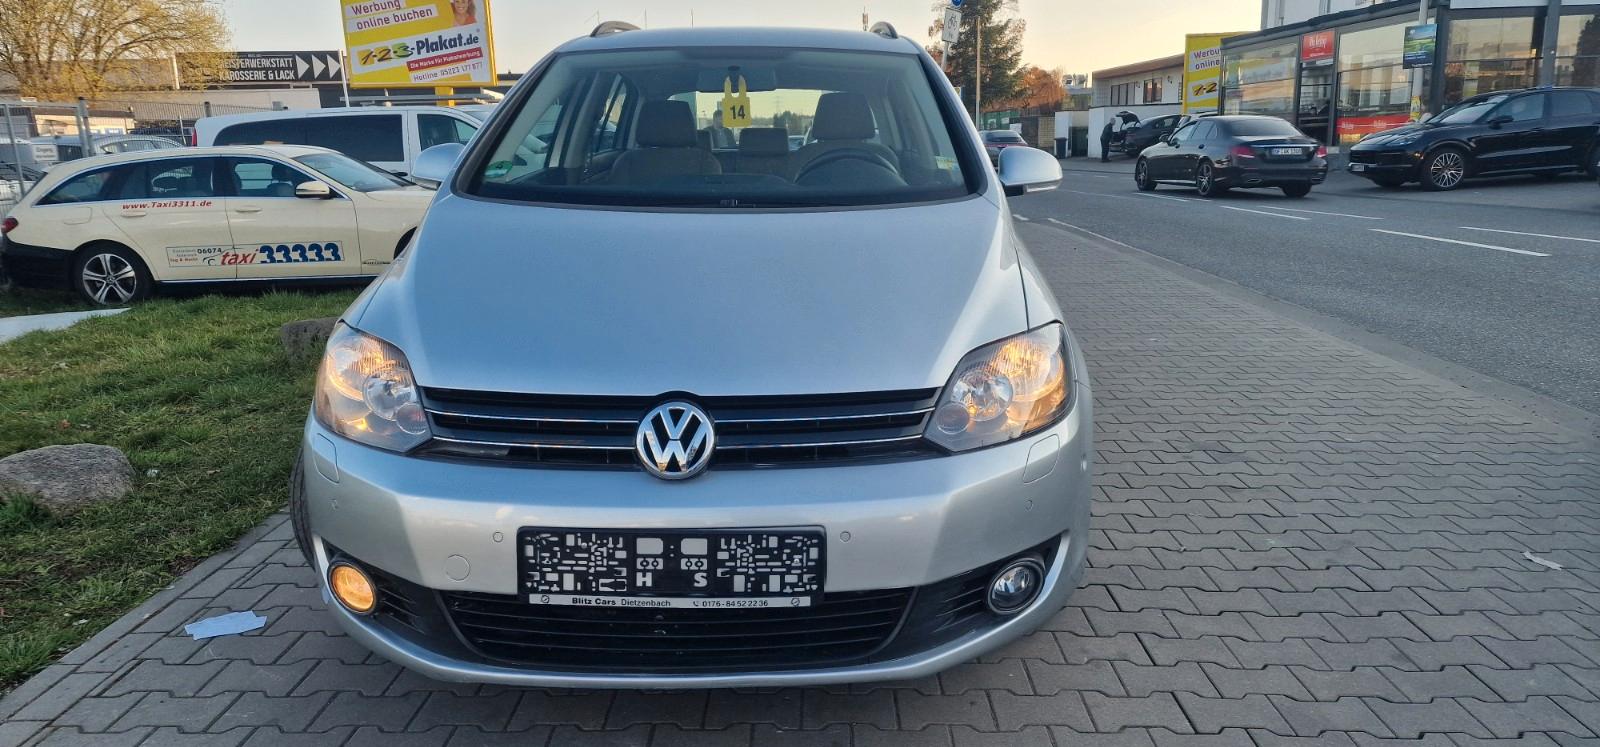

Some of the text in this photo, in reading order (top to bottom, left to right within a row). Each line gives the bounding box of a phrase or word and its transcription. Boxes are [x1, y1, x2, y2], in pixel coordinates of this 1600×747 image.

[352, 0, 401, 15] Werbung
[356, 7, 433, 30] online buchen
[274, 70, 296, 80] LACK
[413, 71, 438, 81] Hotline
[730, 105, 746, 120] 14
[122, 200, 212, 210] www.Taxi3311.de
[197, 247, 222, 255] 06074
[220, 242, 342, 266] taxi 33333
[640, 405, 709, 474] VW
[571, 597, 592, 605] Blitz
[594, 597, 617, 606] Cars
[621, 598, 671, 607] Dietzenbach
